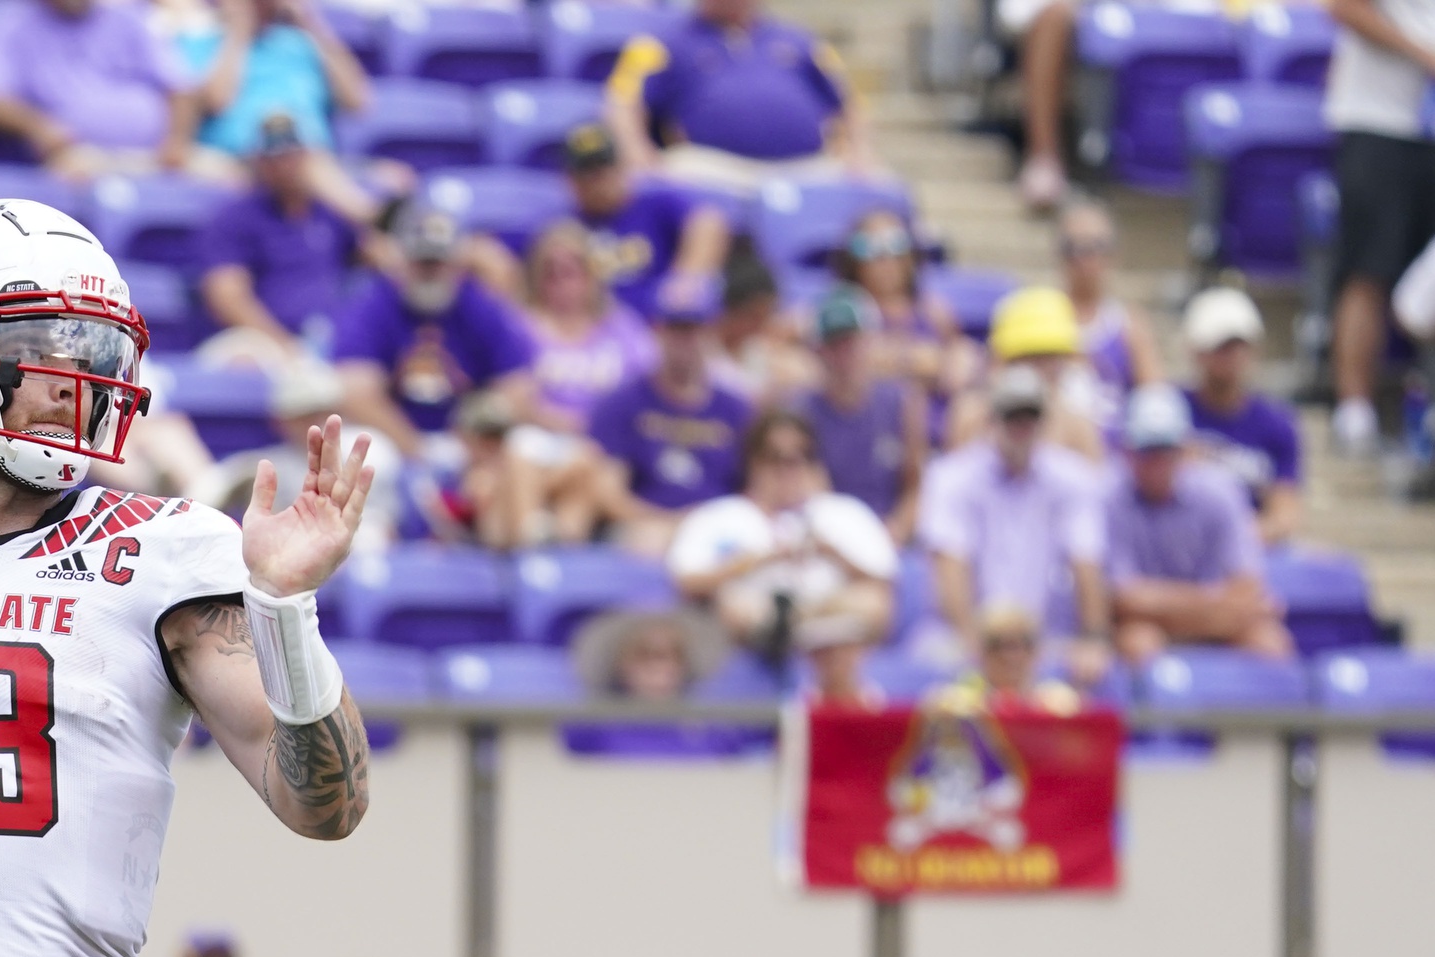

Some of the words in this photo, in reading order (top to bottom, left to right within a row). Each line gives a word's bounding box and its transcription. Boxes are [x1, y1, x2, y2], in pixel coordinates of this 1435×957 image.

[16, 283, 35, 291] STATE
[80, 274, 106, 294] HTT
[100, 536, 141, 587] C
[36, 569, 96, 582] adidas
